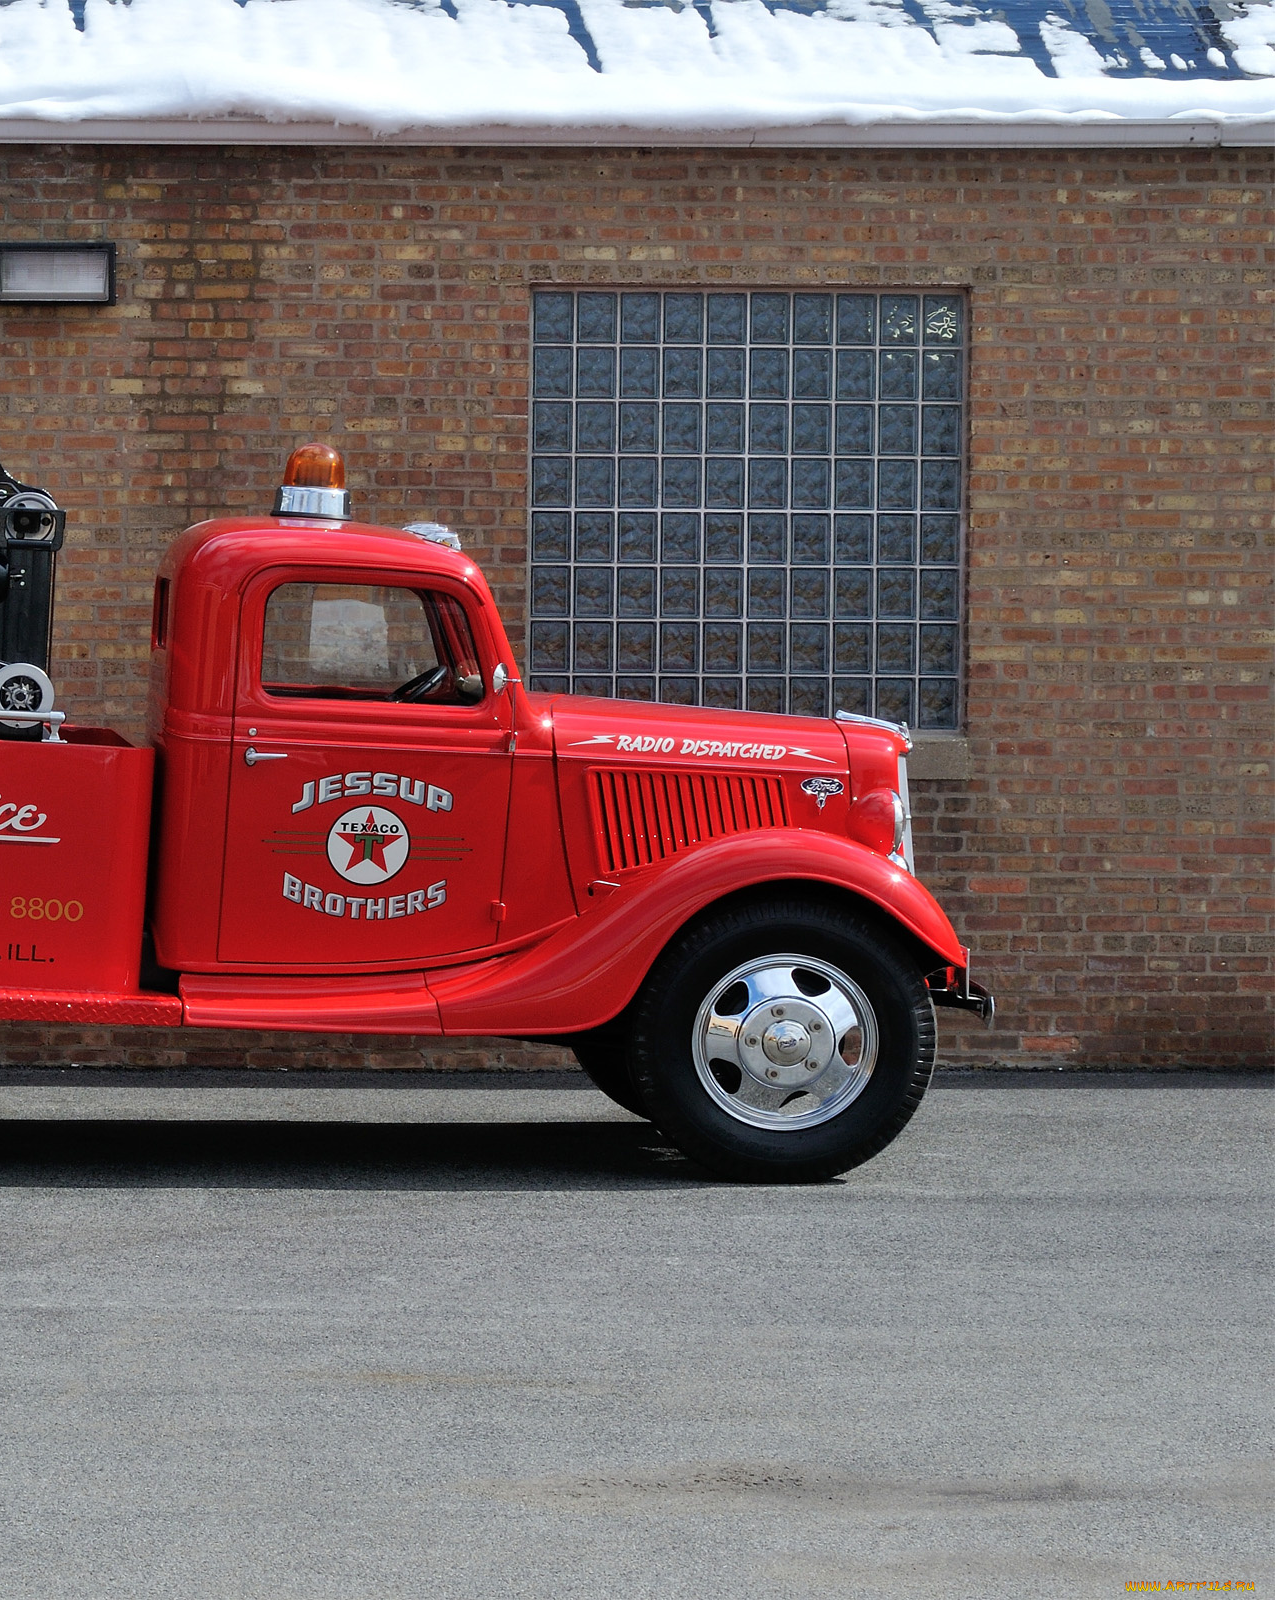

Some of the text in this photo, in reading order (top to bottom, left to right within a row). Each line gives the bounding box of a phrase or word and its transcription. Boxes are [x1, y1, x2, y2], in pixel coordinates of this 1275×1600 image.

[616, 735, 787, 760] RADIO DISPATCHED
[291, 771, 454, 814] JESSUP
[340, 822, 400, 834] TEXACO
[282, 870, 447, 920] BROTHERS
[9, 896, 85, 922] 8800
[7, 943, 55, 963] ILL.
